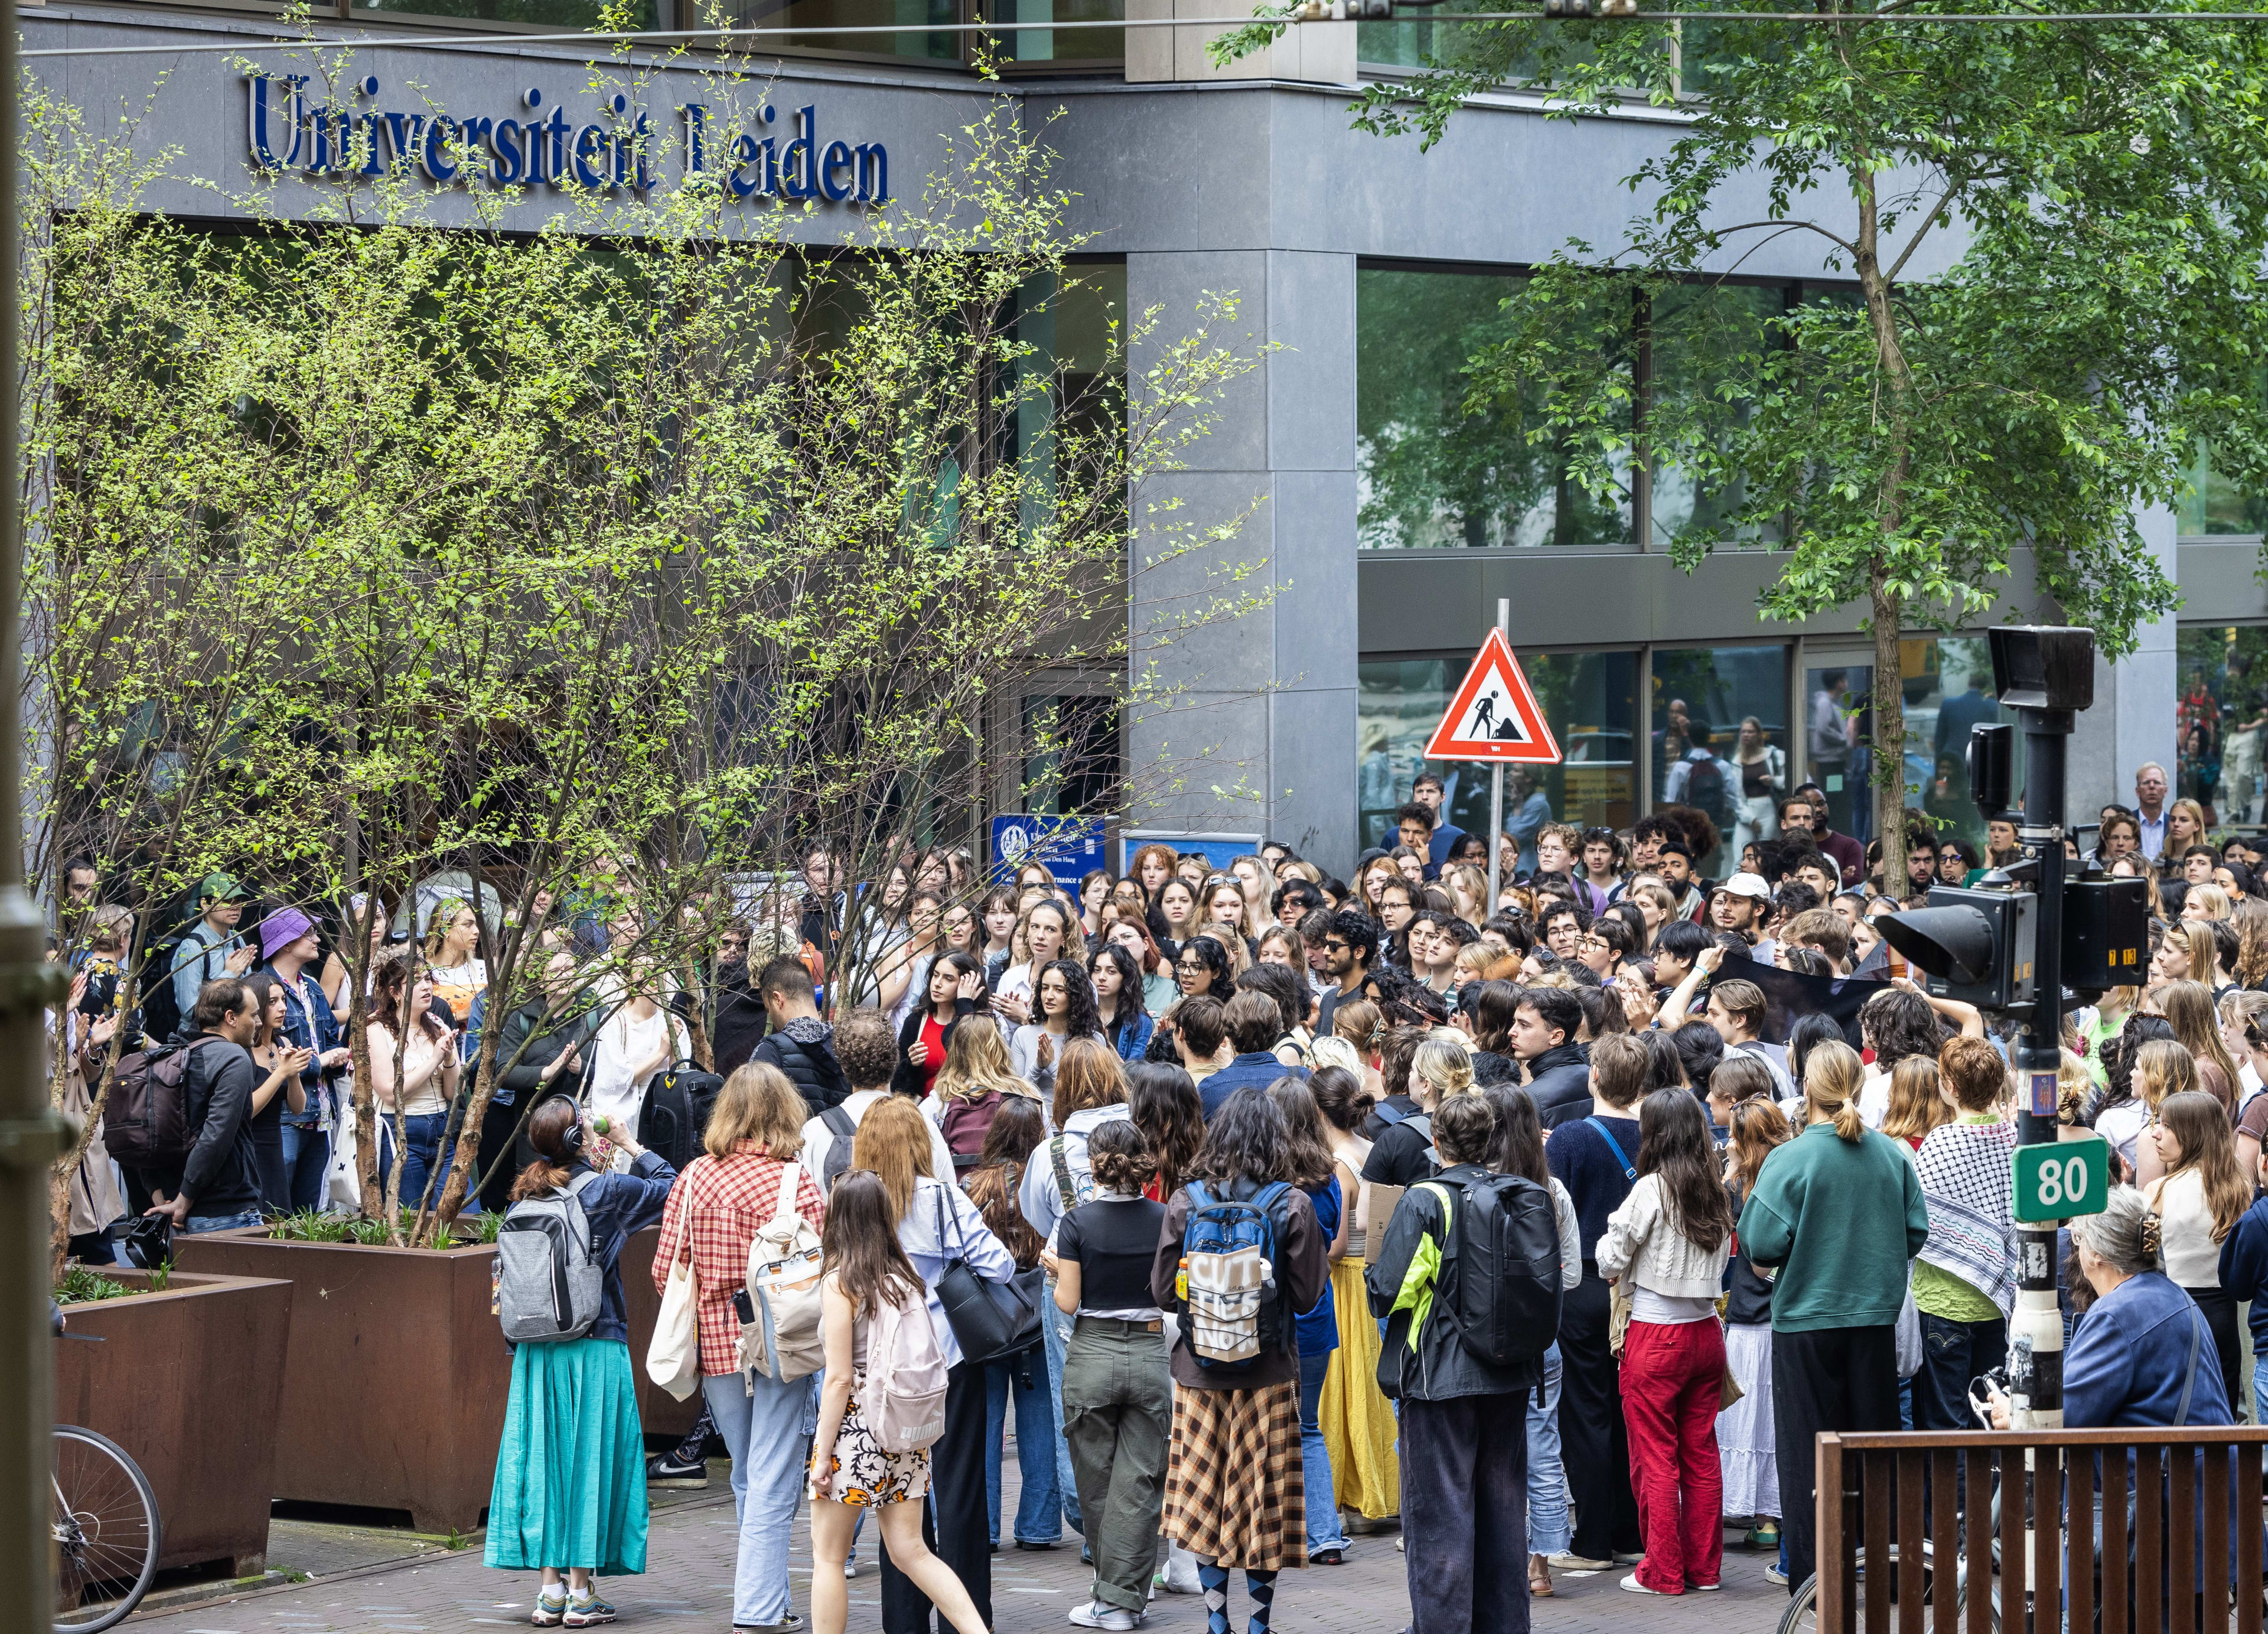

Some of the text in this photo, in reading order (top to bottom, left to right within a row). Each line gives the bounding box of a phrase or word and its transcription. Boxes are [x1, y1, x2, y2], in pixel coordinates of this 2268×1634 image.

[243, 74, 888, 203] Universiteit Leiden
[2110, 949, 2135, 965] 7 13
[2038, 1156, 2087, 1205] 80
[1192, 1251, 1260, 1293] CUT
[1195, 1290, 1260, 1321] TIES
[900, 1420, 940, 1442] PUMA
